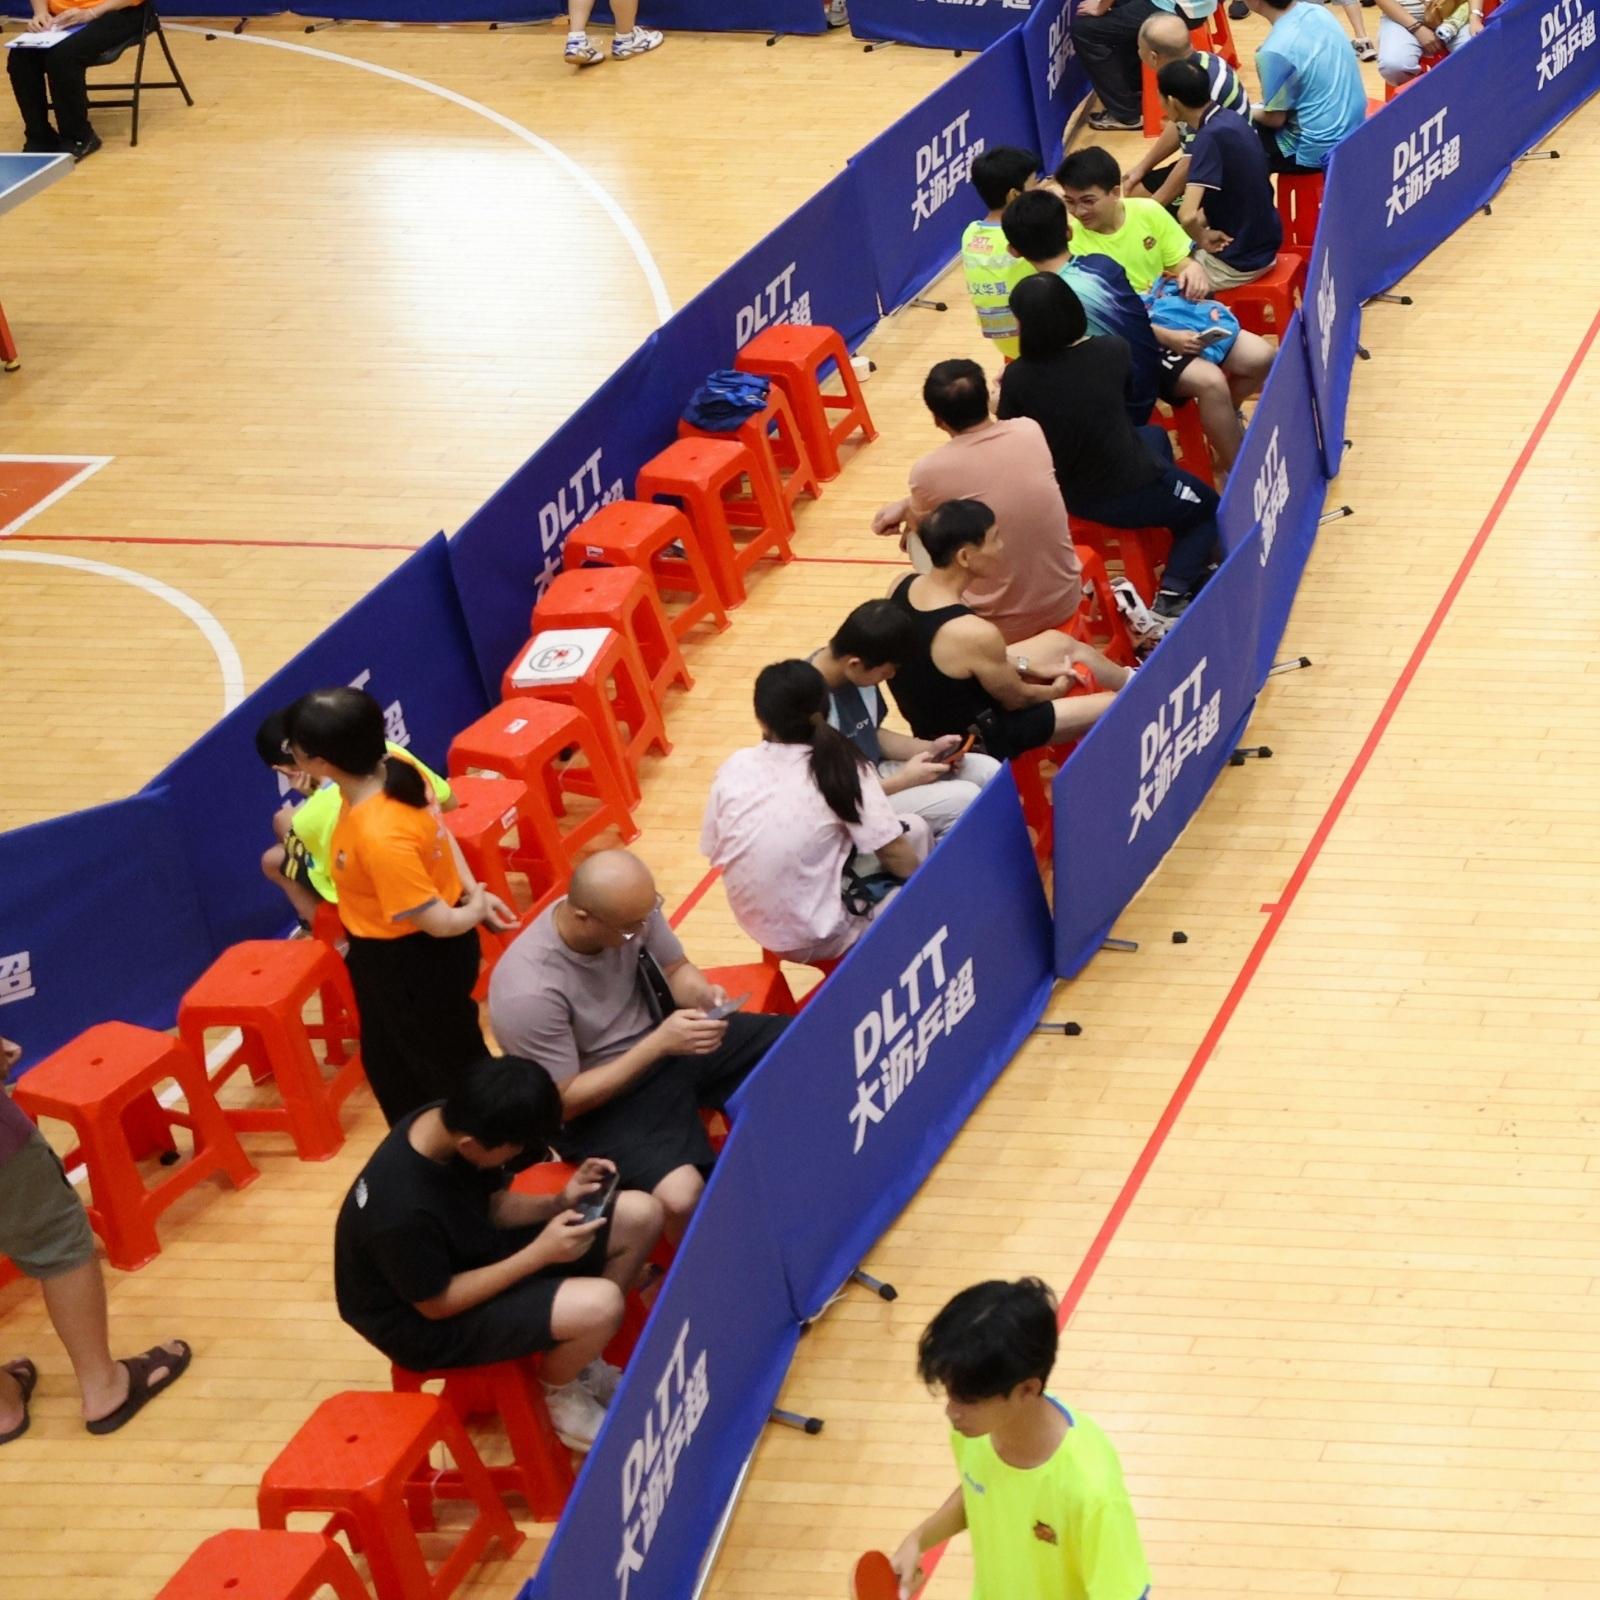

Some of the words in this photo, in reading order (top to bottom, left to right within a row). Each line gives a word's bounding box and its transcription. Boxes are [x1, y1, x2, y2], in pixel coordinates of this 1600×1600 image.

[1536, 5, 1596, 90] 大沥乒超
[917, 110, 969, 184] DLTT
[1386, 133, 1460, 227] 大沥乒超
[1393, 106, 1447, 181] DLTT
[1128, 689, 1220, 843] 大沥乒超
[1140, 657, 1206, 778] DLTT
[849, 958, 976, 1154] 大沥乒超
[854, 923, 948, 1078] DLTT
[614, 1350, 709, 1581] 大沥乒超
[622, 1320, 689, 1523] DLTT
